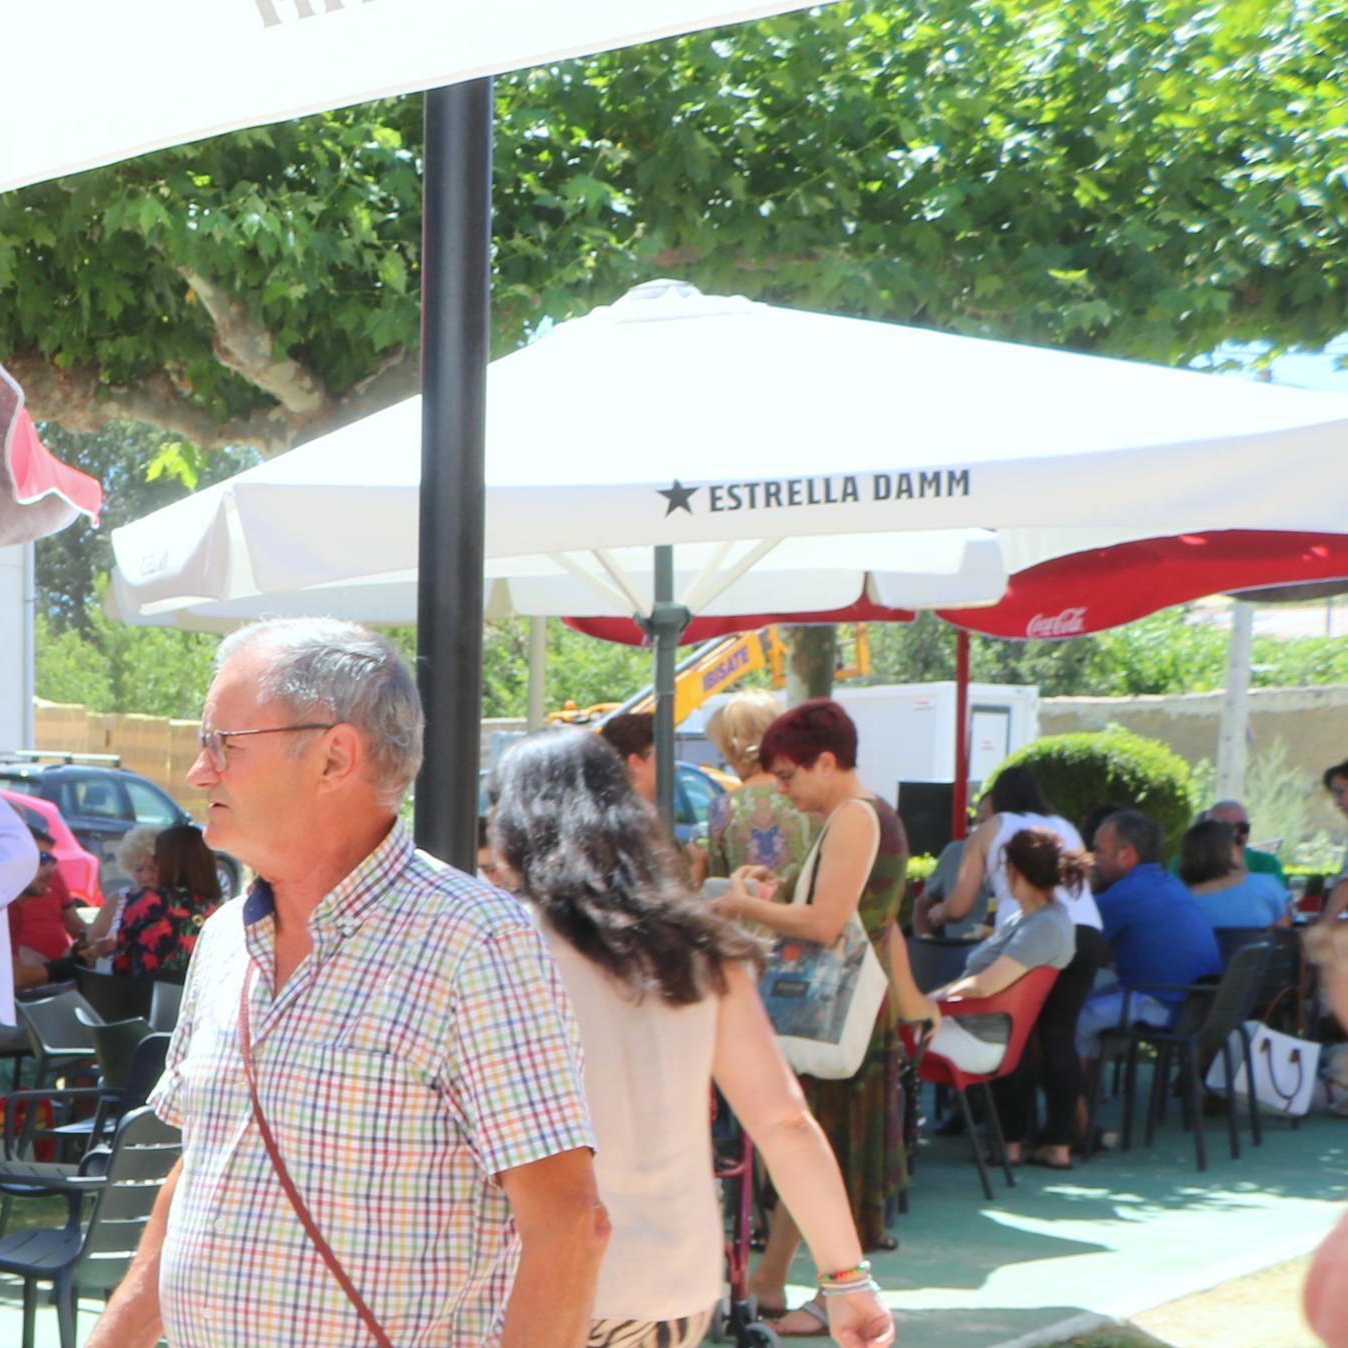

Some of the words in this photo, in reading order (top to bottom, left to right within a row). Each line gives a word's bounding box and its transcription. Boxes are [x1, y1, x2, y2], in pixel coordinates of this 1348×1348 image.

[708, 475, 860, 513] ESTRELLA
[872, 468, 971, 502] DAMM
[1026, 607, 1089, 638] Coca-Cola
